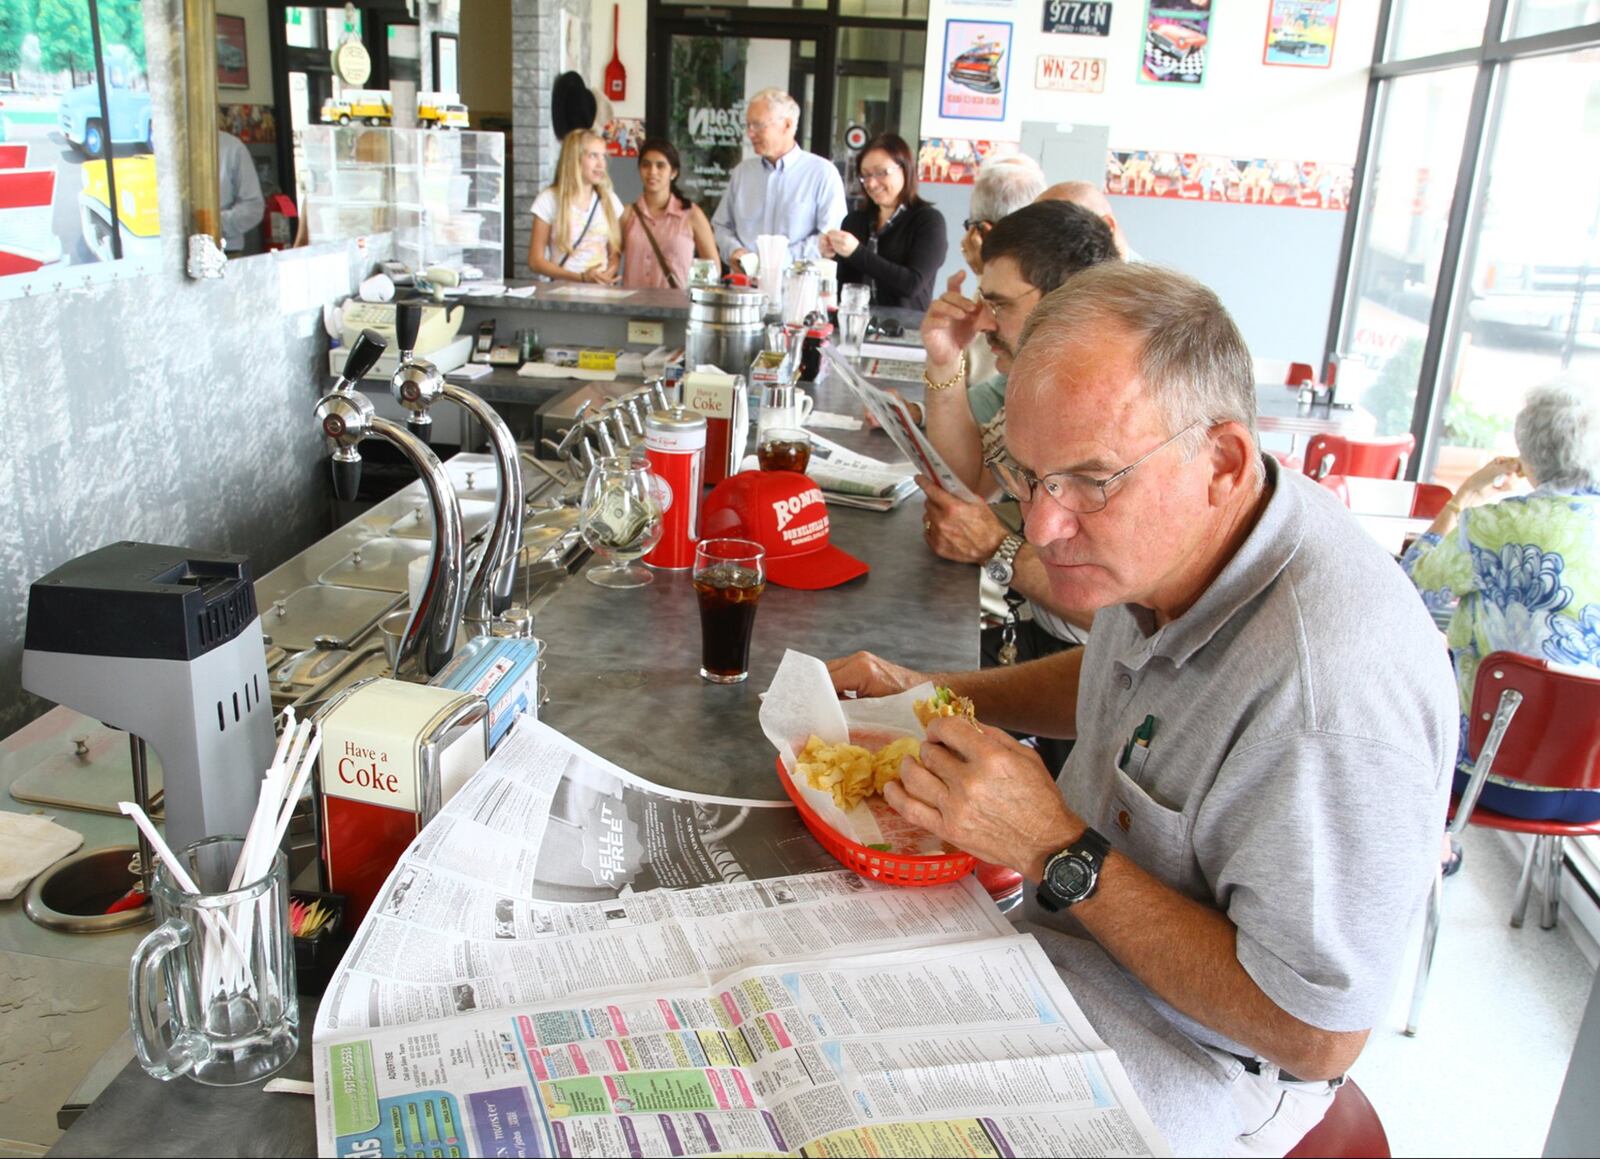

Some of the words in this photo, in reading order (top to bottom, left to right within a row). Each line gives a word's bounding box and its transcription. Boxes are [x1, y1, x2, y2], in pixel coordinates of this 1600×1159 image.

[1043, 58, 1065, 79] WN
[1070, 60, 1101, 82] 219
[692, 397, 723, 411] Coke
[344, 740, 376, 760] Have
[380, 752, 388, 762] a
[338, 757, 399, 793] Coke
[600, 803, 612, 824] IT
[599, 832, 614, 881] SELL
[611, 819, 626, 872] FREE
[385, 1051, 397, 1080] ADVERTISE
[487, 1103, 504, 1140] monster
